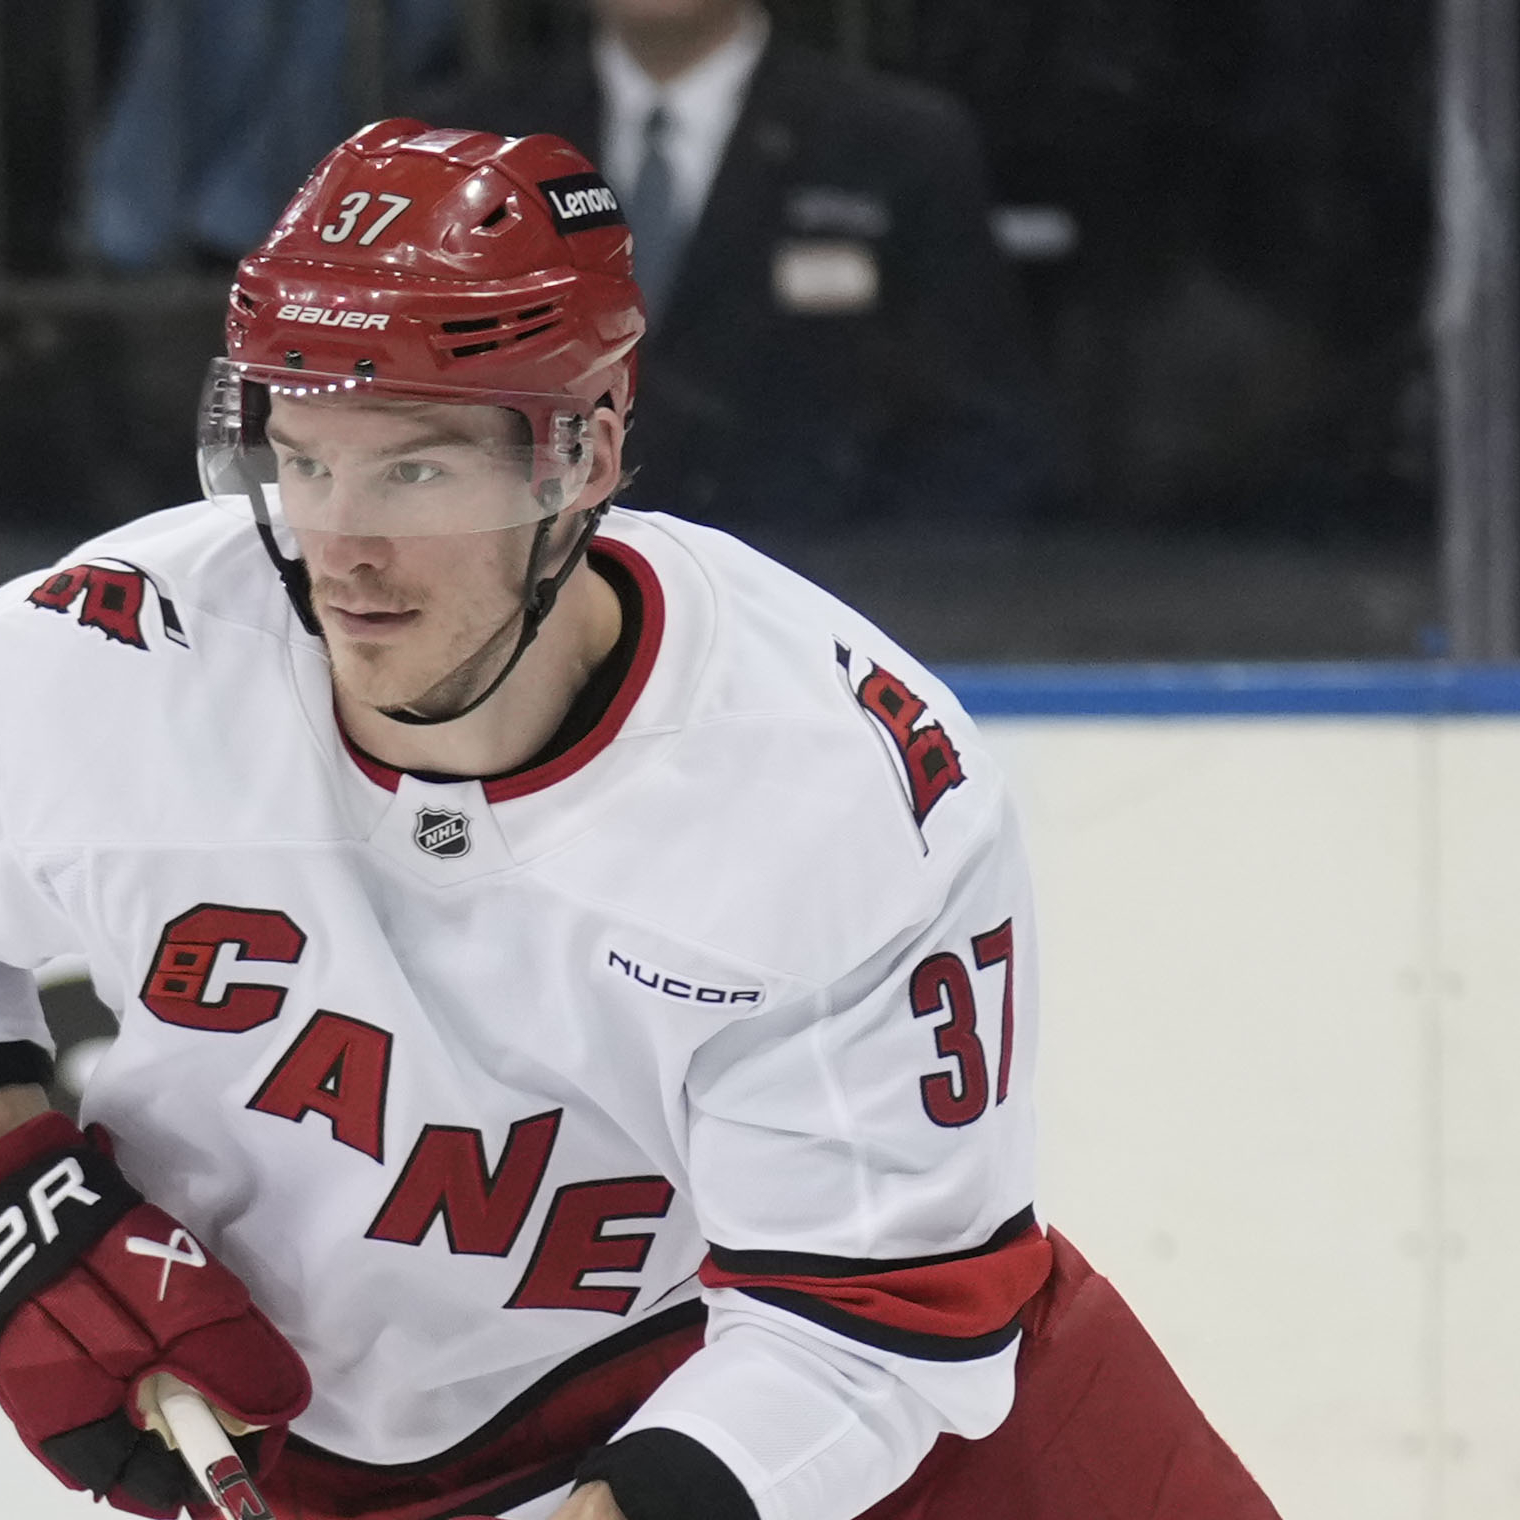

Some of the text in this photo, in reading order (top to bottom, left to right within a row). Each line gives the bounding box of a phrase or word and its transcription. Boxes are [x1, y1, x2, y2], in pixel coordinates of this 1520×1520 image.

[321, 191, 411, 246] 37
[548, 187, 618, 219] Lenovo
[277, 303, 390, 331] BAUER
[424, 821, 463, 848] NHL
[607, 950, 762, 1005] NUCOR
[909, 916, 1014, 1129] 37
[139, 902, 677, 1316] CANE
